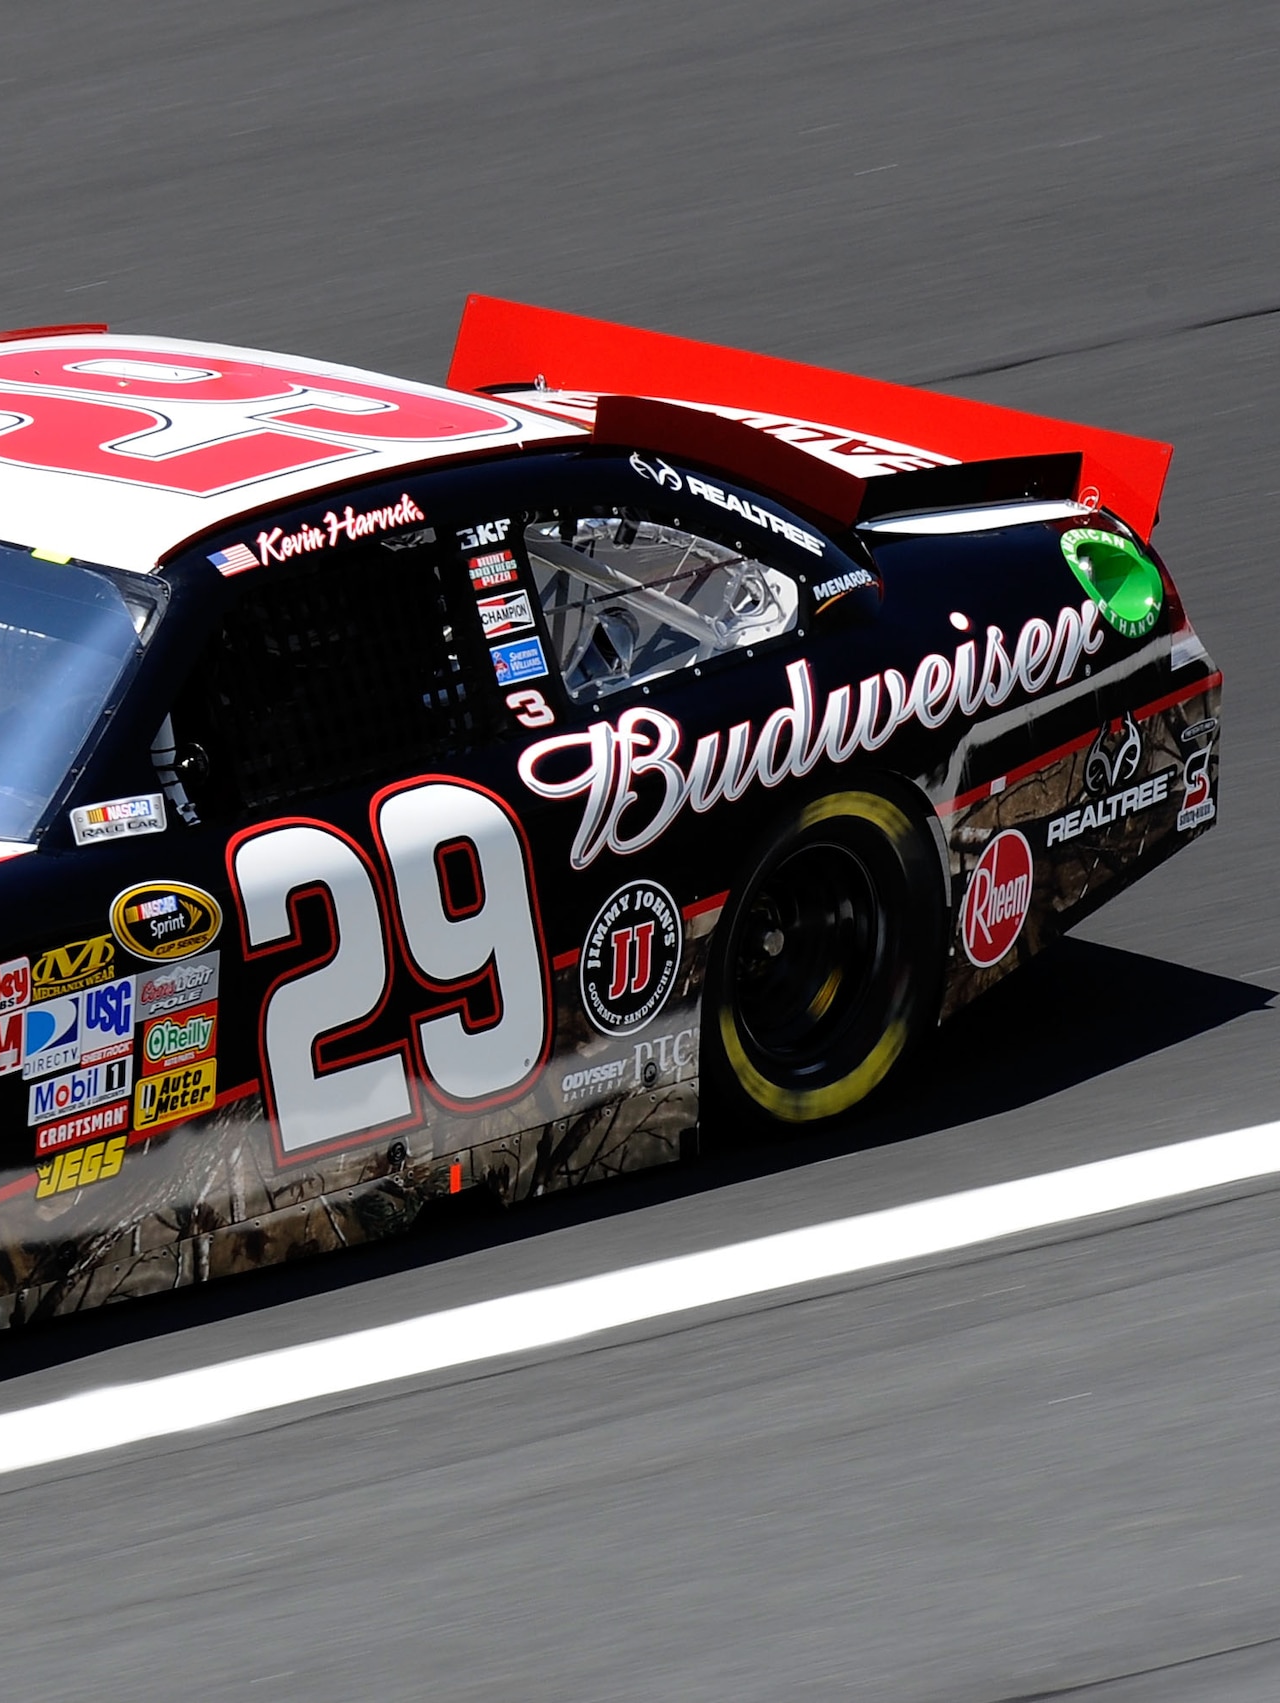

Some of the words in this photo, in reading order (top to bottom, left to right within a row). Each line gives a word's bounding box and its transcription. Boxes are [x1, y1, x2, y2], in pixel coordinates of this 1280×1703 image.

[256, 523, 327, 566] Kevin
[322, 493, 420, 547] Harvick
[686, 475, 824, 557] REALTREE
[477, 552, 506, 567] HUNT
[1061, 529, 1126, 564] AMERICAN
[469, 559, 518, 580] BROTHERS
[481, 570, 512, 587] PIZZA
[812, 568, 873, 601] MENARDS
[480, 603, 527, 625] CHAMPION
[1097, 597, 1161, 637] ETHANOL
[506, 689, 554, 728] 3
[518, 599, 1105, 869] Budweiser
[82, 822, 125, 838] RACE
[127, 819, 158, 832] CAR
[106, 800, 150, 821] NASCAR
[1046, 774, 1170, 847] REALTREE
[140, 895, 178, 920] NASCAR
[968, 840, 1028, 949] Rheem
[150, 913, 186, 939] Sprint
[587, 894, 630, 969] JIMMY
[635, 890, 675, 947] JOHN'S
[156, 942, 177, 955] CUP
[177, 934, 208, 950] SERIES
[609, 920, 655, 1000] JJ
[32, 979, 84, 1002] MECHANIX
[86, 965, 115, 988] WEAR
[141, 980, 177, 1004] Coors
[177, 968, 215, 992] LIGHT
[226, 773, 553, 1168] 29
[86, 980, 131, 1036] USG
[148, 989, 202, 1015] POLE
[588, 982, 622, 1025] GOURMET
[624, 960, 673, 1025] SANDWICHES
[148, 1018, 213, 1059] O'Reilly
[23, 1046, 80, 1077] DIRECTV
[562, 1057, 627, 1092] ODYSSEY
[34, 1067, 99, 1115] Mobil
[156, 1085, 211, 1114] Meter
[159, 1069, 202, 1097] Auto
[563, 1076, 623, 1103] BATTERY
[39, 1107, 125, 1148] CRAFTSMAN
[36, 1136, 128, 1198] JEGS
